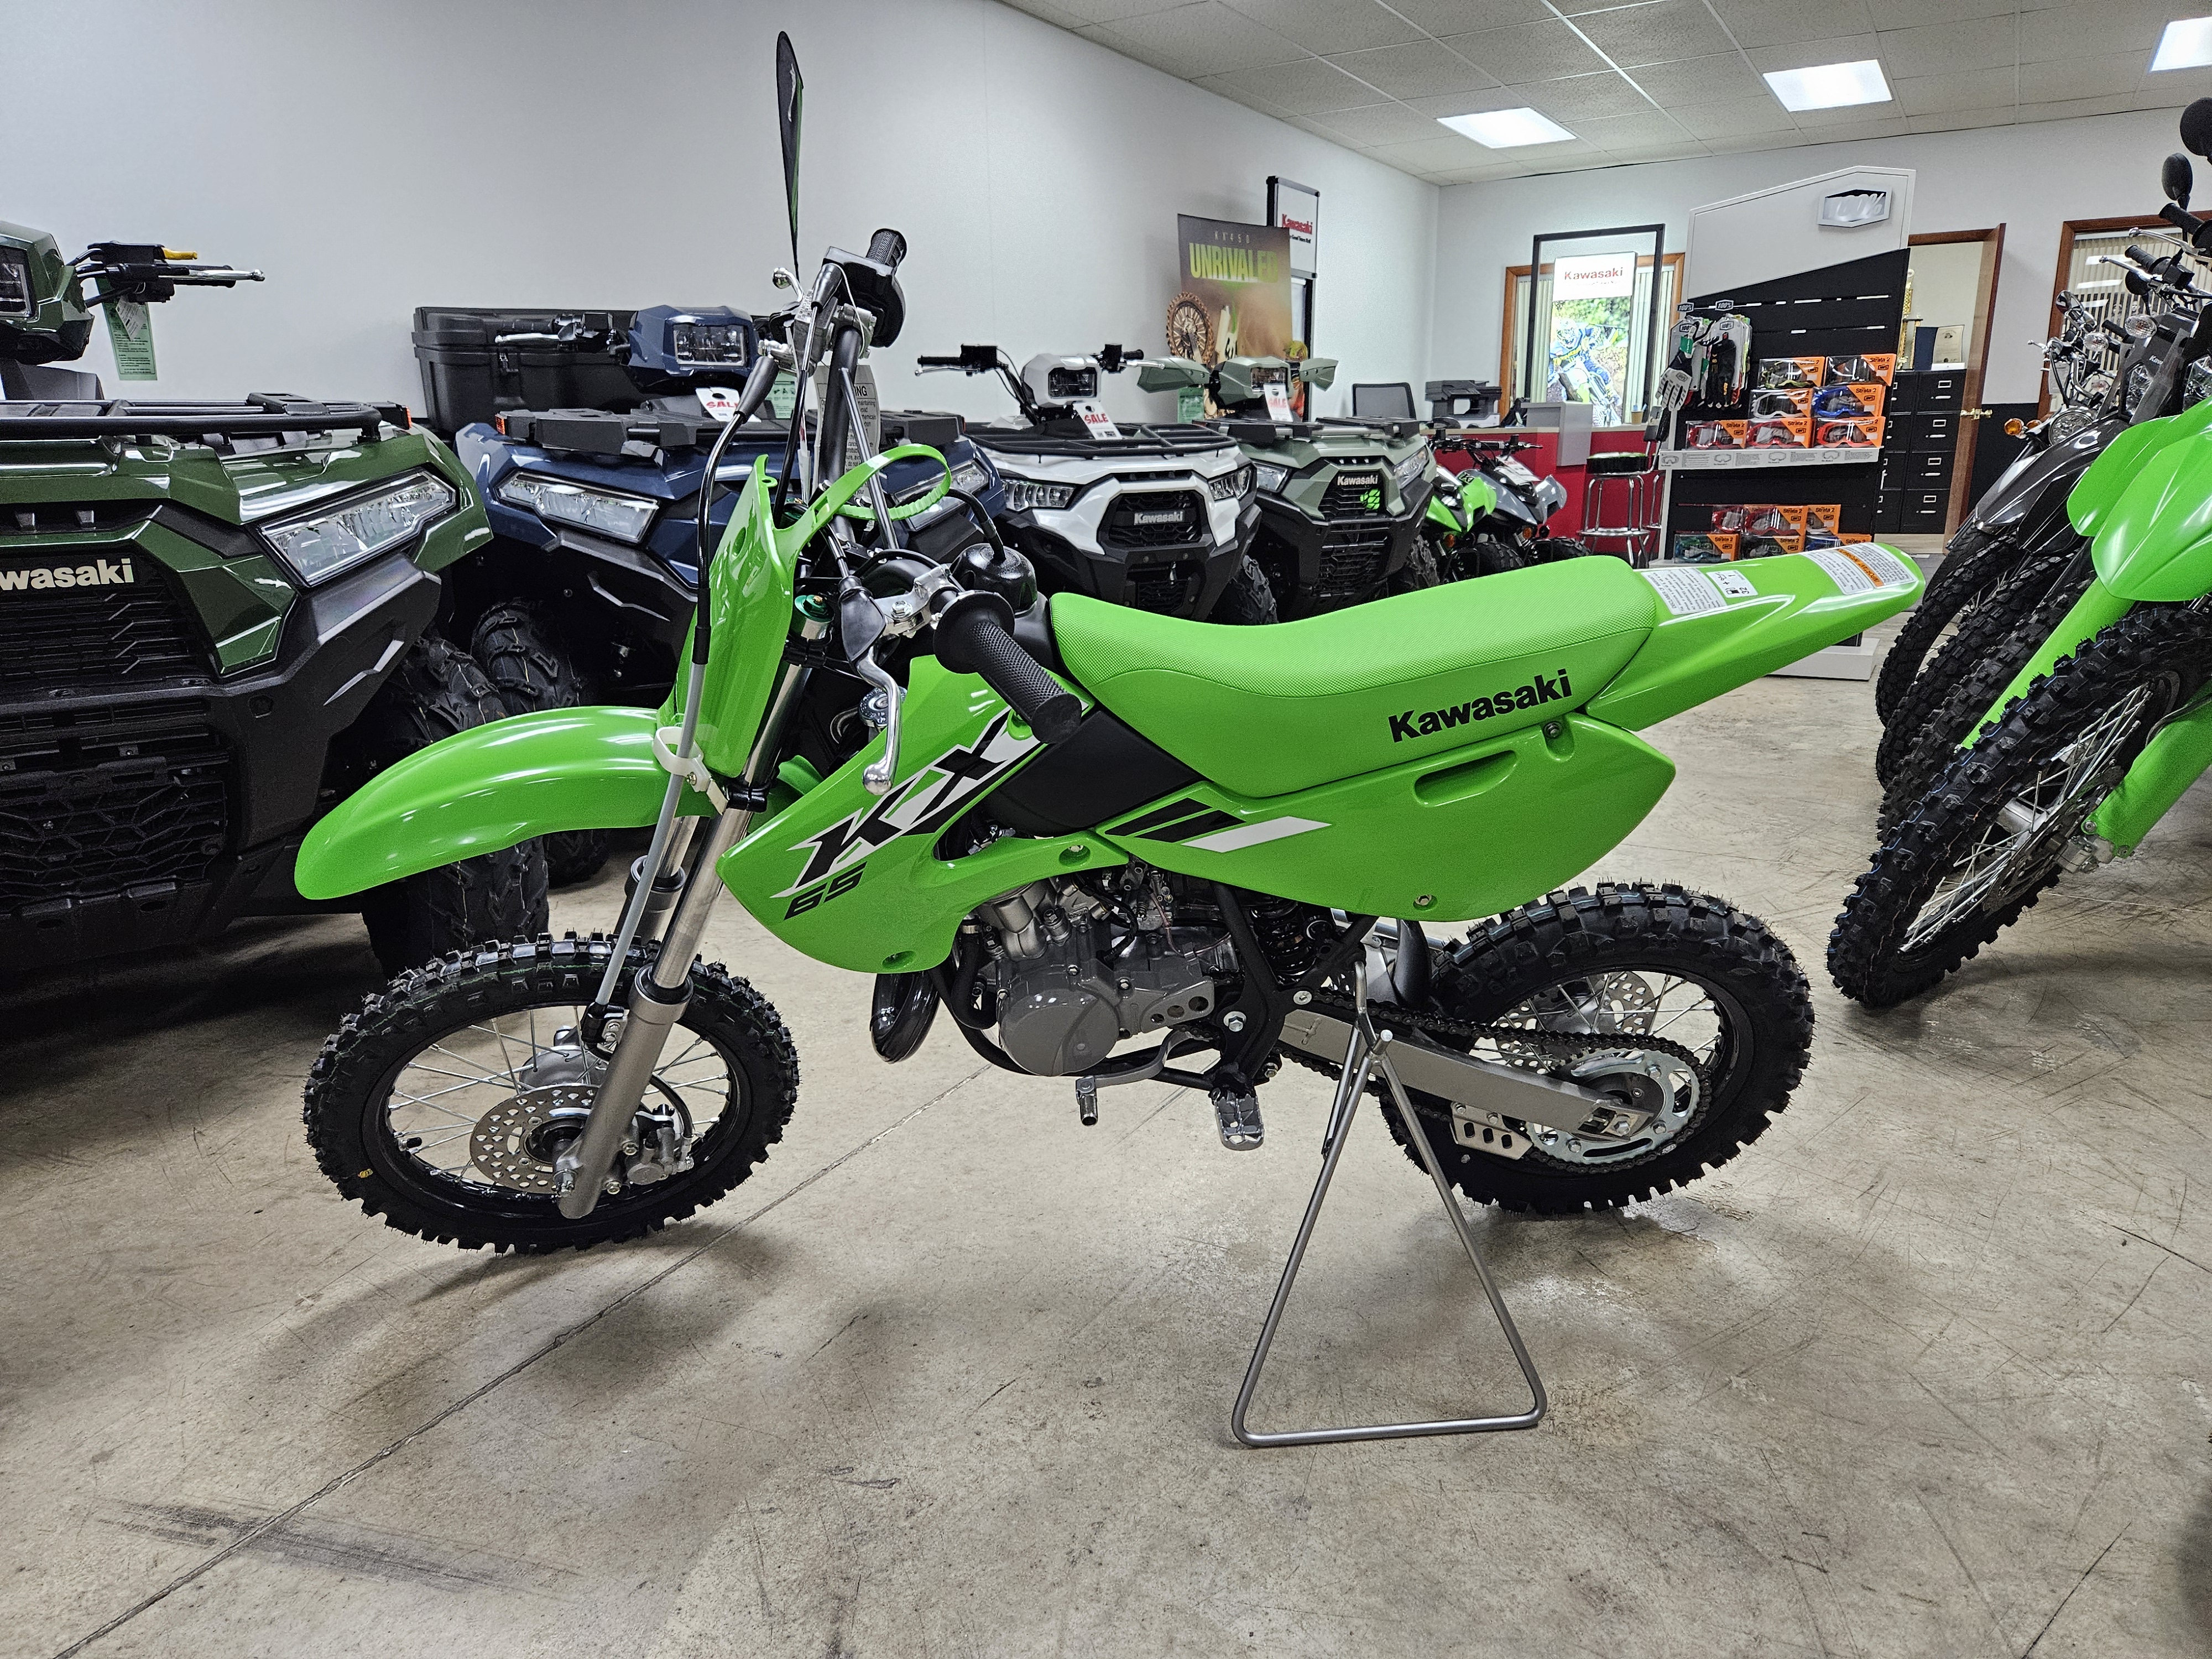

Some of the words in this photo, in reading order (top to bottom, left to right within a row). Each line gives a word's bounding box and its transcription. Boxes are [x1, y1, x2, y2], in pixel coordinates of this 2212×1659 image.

[1190, 242, 1279, 283] UNRIVALED
[1564, 267, 1623, 280] Kawasaki
[1084, 413, 1109, 425] SALE
[1337, 475, 1378, 486] Kawasaki
[1134, 511, 1184, 524] Kawasaki
[1739, 587, 1750, 595] 32
[1388, 668, 1572, 743] Kawasaki
[790, 706, 1011, 890] KX
[783, 860, 868, 921] 65
